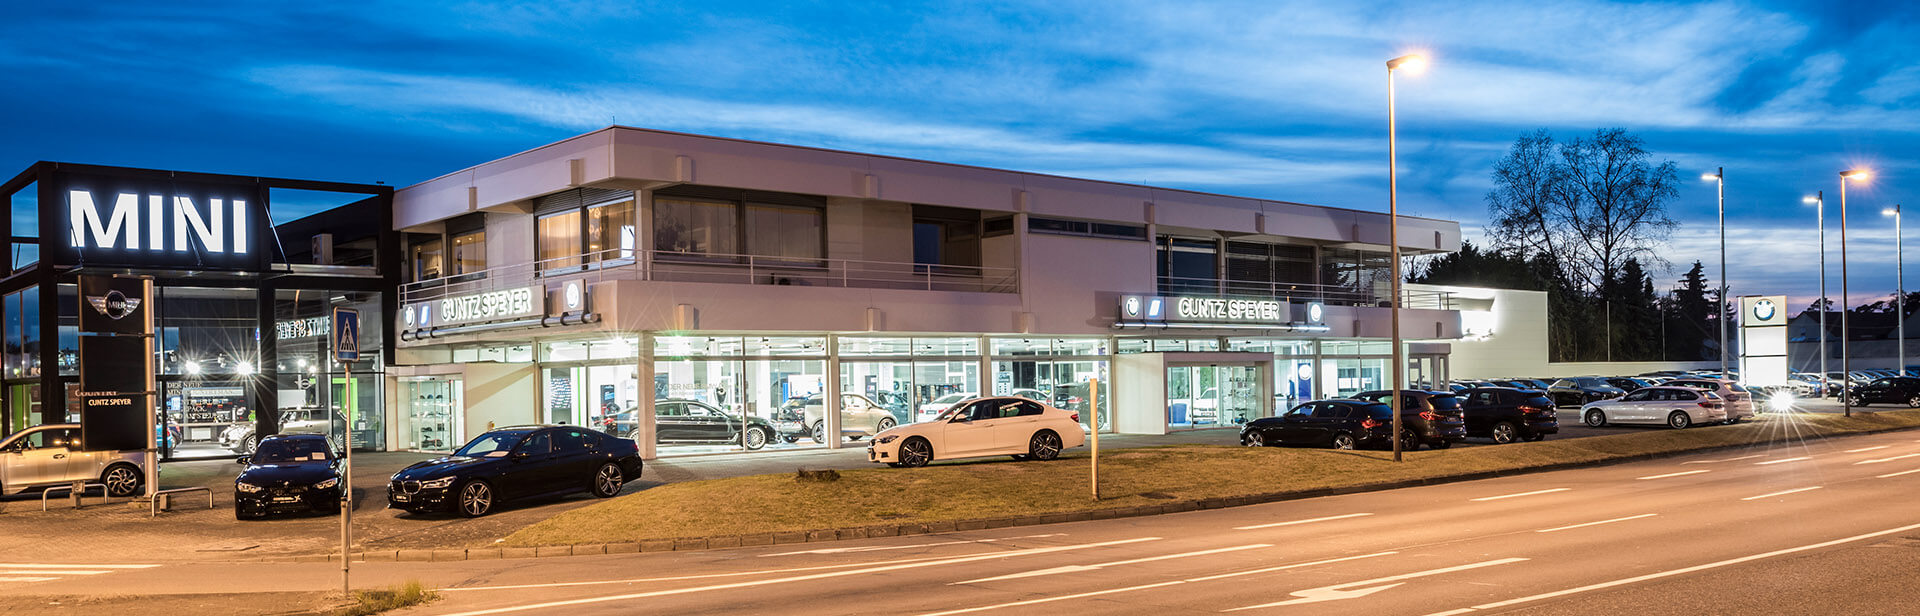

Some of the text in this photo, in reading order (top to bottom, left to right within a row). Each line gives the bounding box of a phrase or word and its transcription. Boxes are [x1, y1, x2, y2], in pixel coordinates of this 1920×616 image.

[70, 190, 246, 253] MINI
[441, 287, 531, 321] CUNTZ SPEYER
[1179, 297, 1279, 320] CUNTZ SPEYER
[110, 398, 132, 406] SPEYER
